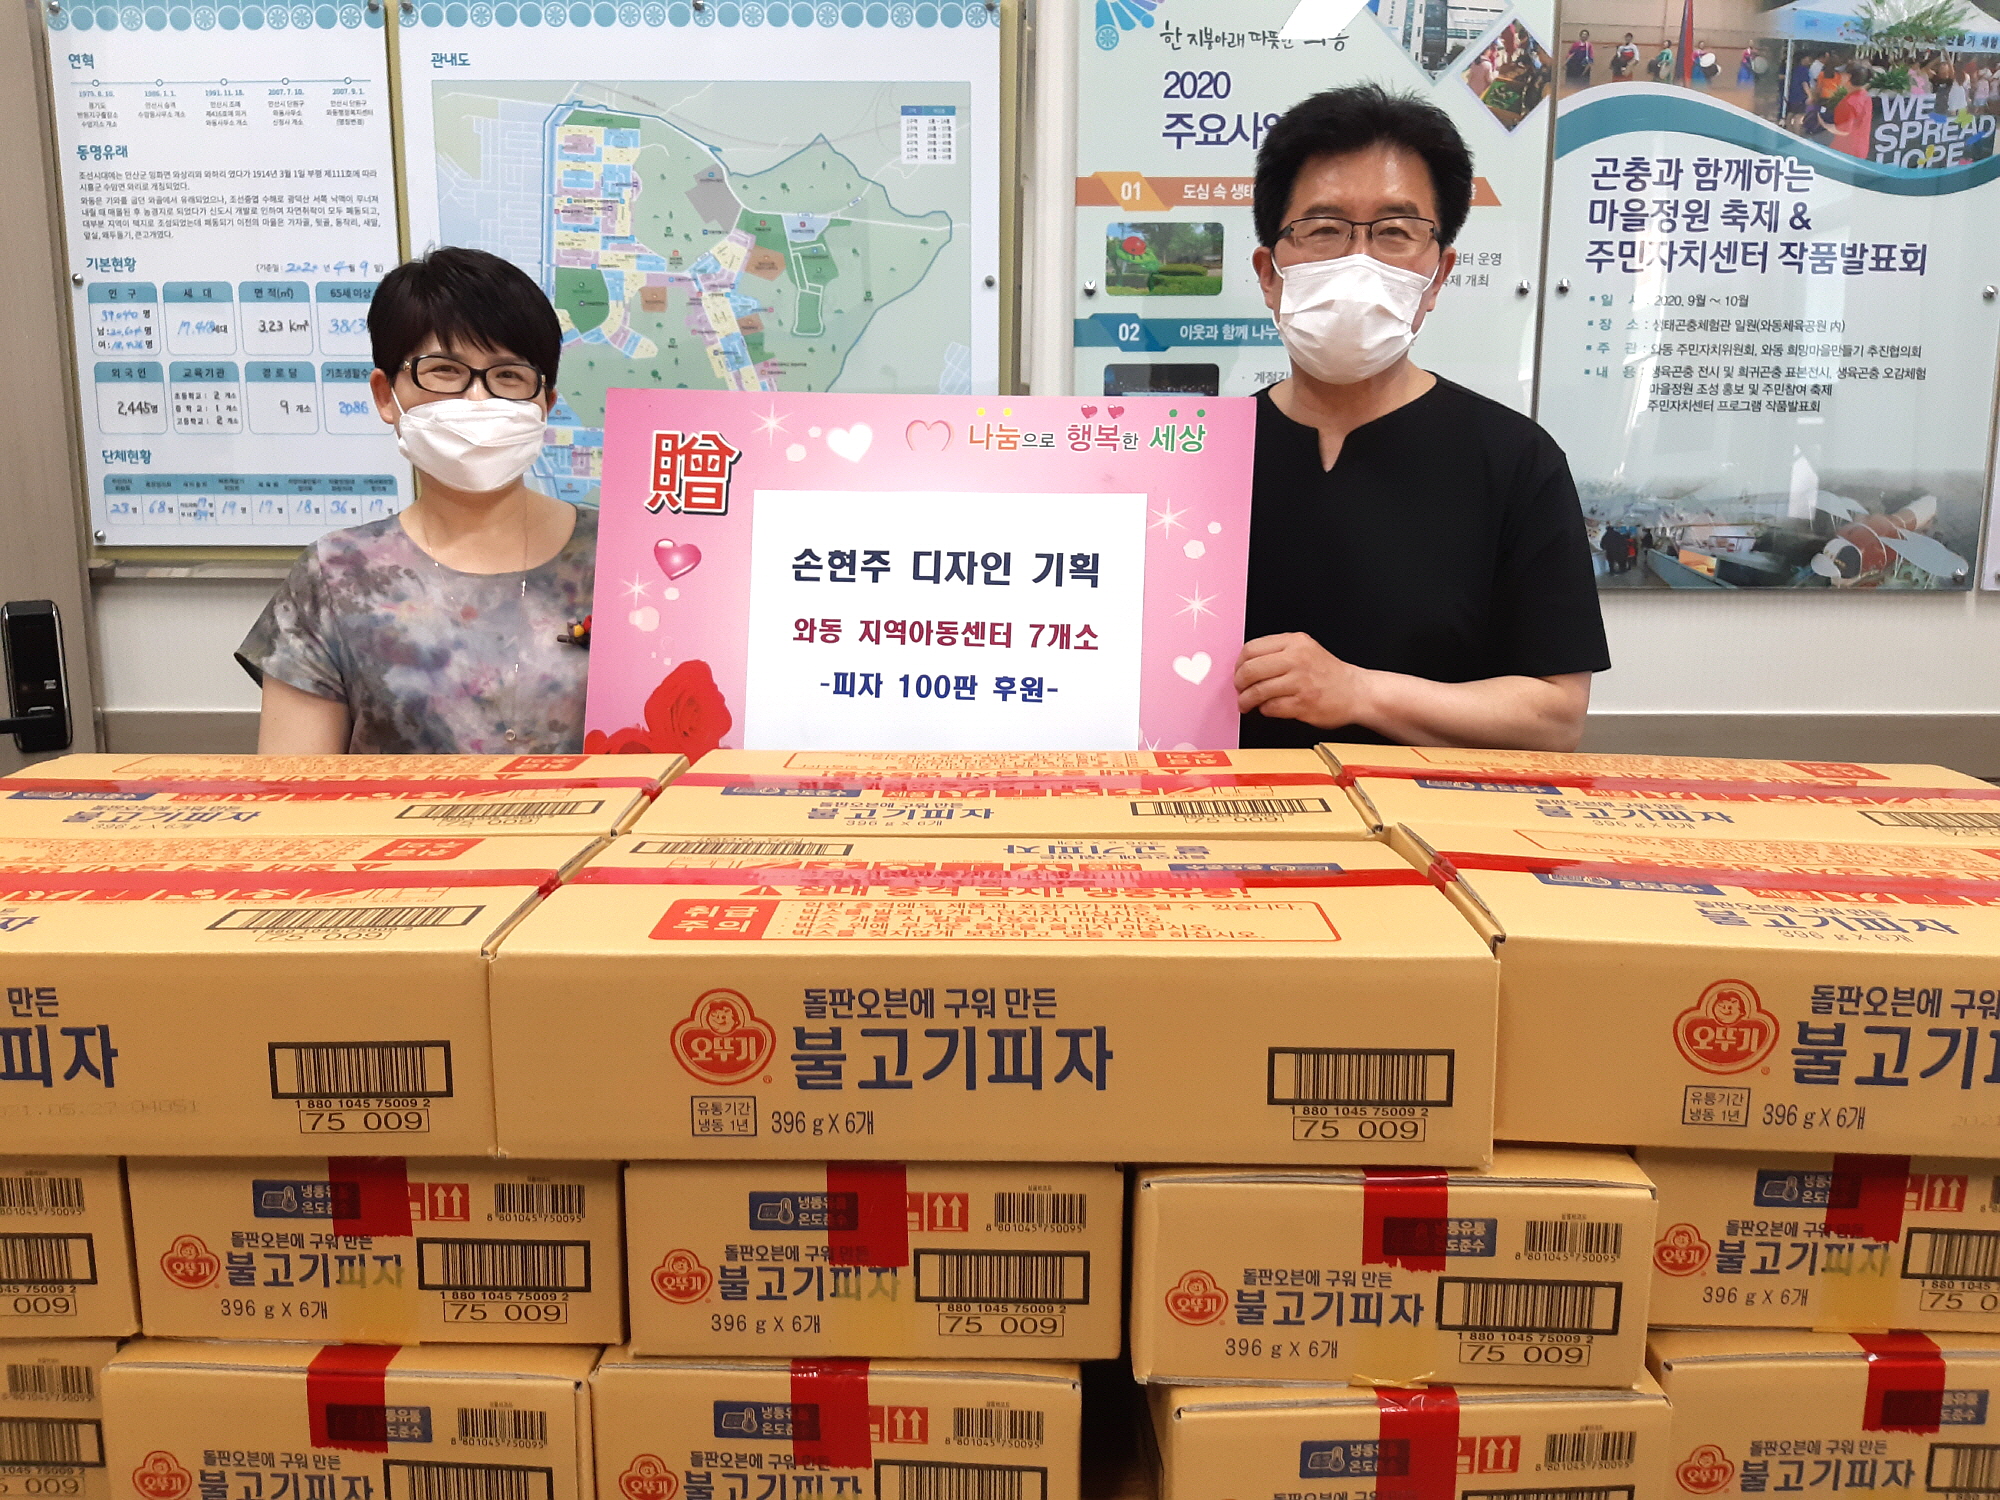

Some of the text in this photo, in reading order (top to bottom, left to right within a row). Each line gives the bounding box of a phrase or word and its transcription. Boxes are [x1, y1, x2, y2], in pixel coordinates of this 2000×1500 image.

[1160, 20, 1245, 50] 한 지붕아래
[68, 53, 95, 70] 연혁
[431, 52, 470, 68] 관내도
[1163, 71, 1232, 99] 2020
[1881, 93, 1936, 121] WE
[1875, 115, 1996, 152] SPREAD
[76, 144, 128, 161] 동명유래
[253, 170, 278, 179] 1914년
[1591, 156, 1814, 192] 곤충과 함께하는
[1121, 181, 1141, 200] 01
[1183, 184, 1210, 200] 도심
[1213, 184, 1227, 200] 속
[1588, 198, 1812, 234] 마을정원 축제 &
[86, 257, 136, 273] 기본현황
[1478, 252, 1502, 266] 운영
[1585, 240, 1928, 277] 주민자치센터 작품발표회
[1465, 274, 1489, 287] 개최
[1654, 295, 1684, 307] 2020.
[1688, 295, 1705, 307] 9월
[1725, 295, 1749, 307] 10월
[1118, 323, 1282, 341] 02 이웃과 함께 나누
[1651, 344, 1673, 356] 와동
[1761, 344, 1783, 356] 와동
[1787, 344, 1864, 357] 희망마을만들기
[1867, 345, 1922, 358] 추진협의회
[1698, 366, 1719, 379] 전시
[1723, 366, 1734, 378] 및
[1738, 366, 1782, 379] 희귀곤충
[1837, 367, 1879, 380] 생육곤충
[1883, 367, 1926, 380] 오감체험
[1650, 383, 1832, 396] 마을정원 조성 홍보 및 주민참여 축제
[296, 405, 311, 413] 개소
[1648, 400, 1820, 412] 주민자치센터 프로그램 작품발표회
[968, 422, 1206, 452] 나눔으로 행복한 세상
[102, 449, 151, 464] 단체현황
[645, 430, 741, 514] 贈
[792, 548, 1100, 588] 손현주 디자인 기획
[793, 618, 1099, 651] 와동 지역아동센터 7개소
[820, 672, 1059, 703] -피자 100판 후원-
[684, 905, 759, 918] 취급
[1695, 908, 1959, 934] 불고기피자
[673, 919, 752, 933] 주의
[7, 987, 59, 1018] 만든
[803, 988, 1057, 1019] 돌판오븐에 구워 만든
[1811, 984, 1943, 1018] 돌판오븐에
[0, 1024, 118, 1088] 피자
[691, 1025, 1113, 1090] 오뚜기 불고기피자
[1692, 1022, 2000, 1090] 오뚜기 불고기
[338, 1100, 371, 1109] 1045
[375, 1100, 418, 1109] 75009
[697, 1101, 750, 1116] 유통기간
[1690, 1092, 1744, 1107] 유통기간
[305, 1112, 423, 1131] 75 009
[1303, 1107, 1415, 1117] 880 1045 75009
[1690, 1104, 1866, 1130] 냉동 1년 396 6개
[698, 1118, 724, 1132] 냉동
[730, 1118, 749, 1133] 1년
[771, 1111, 806, 1135] 396
[812, 1115, 824, 1135] g
[845, 1111, 874, 1135] 6개
[1300, 1120, 1418, 1139] 75 009
[1726, 1219, 1798, 1238] 돌판오븐에
[231, 1231, 305, 1250] 돌판오븐에
[724, 1245, 800, 1263] 돌판오븐에
[172, 1250, 404, 1289] 오뚜기 불고기피자
[1243, 1268, 1392, 1288] 돌판오븐에 구워 만든
[451, 1304, 561, 1321] 75 009
[1177, 1289, 1424, 1327] 오뚜기 불고기피자
[711, 1314, 821, 1333] 396 6개
[945, 1317, 1058, 1334] 75 009
[1225, 1338, 1338, 1358] 396 6개
[1467, 1344, 1583, 1363] 75 009
[1750, 1440, 1887, 1456] 돌판오븐에 구워 만든
[203, 1450, 275, 1468] 돌판오븐에
[1739, 1458, 1916, 1493] 불고기피자
